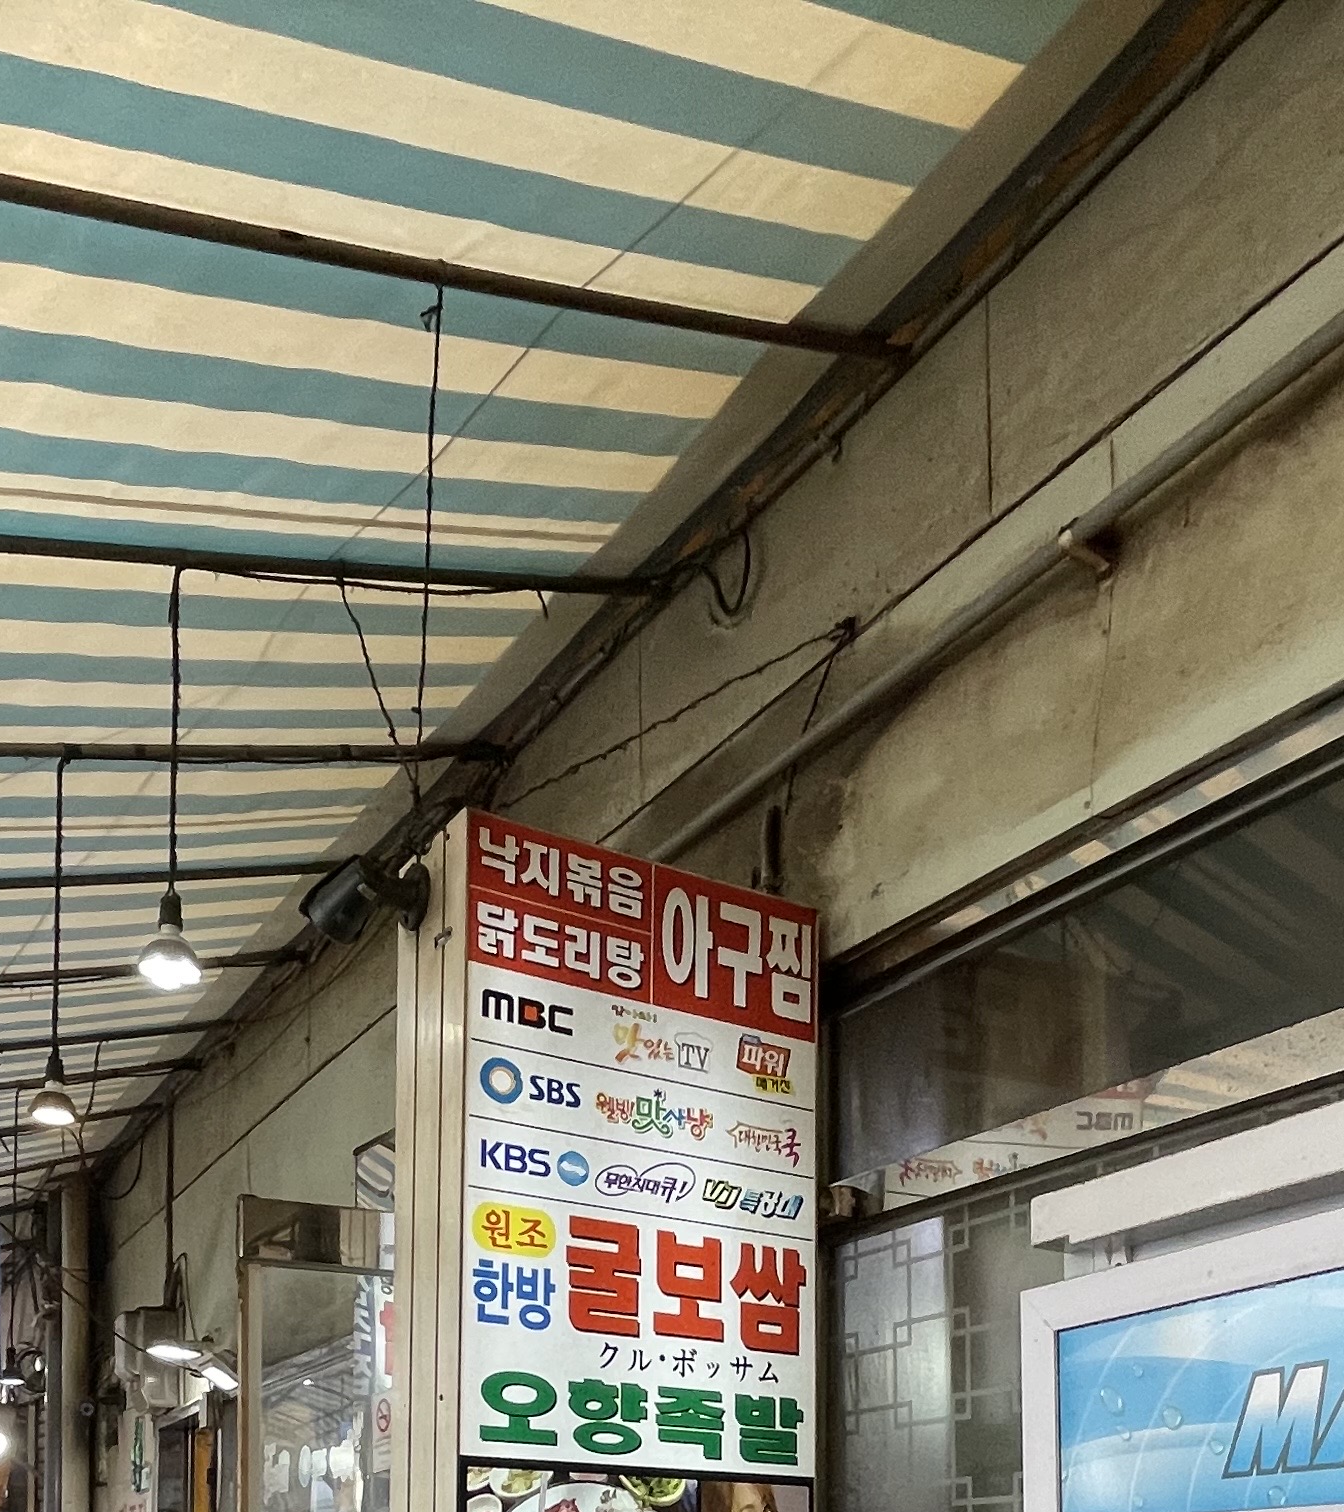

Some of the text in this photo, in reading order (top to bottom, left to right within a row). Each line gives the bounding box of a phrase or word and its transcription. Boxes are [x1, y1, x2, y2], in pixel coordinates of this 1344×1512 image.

[479, 826, 644, 919] 낙지볶음
[476, 900, 645, 990] 닭도리탕
[662, 886, 812, 1024] 아구찜
[481, 988, 574, 1036] MBC
[680, 1042, 711, 1073] TV
[741, 1044, 785, 1077] 파워
[529, 1074, 582, 1108] SBS
[480, 1139, 552, 1178] KBS
[481, 1208, 548, 1250] 원조
[472, 1258, 556, 1331] 한방
[565, 1214, 807, 1357] 굴보쌈
[479, 1370, 805, 1466] 오향족발
